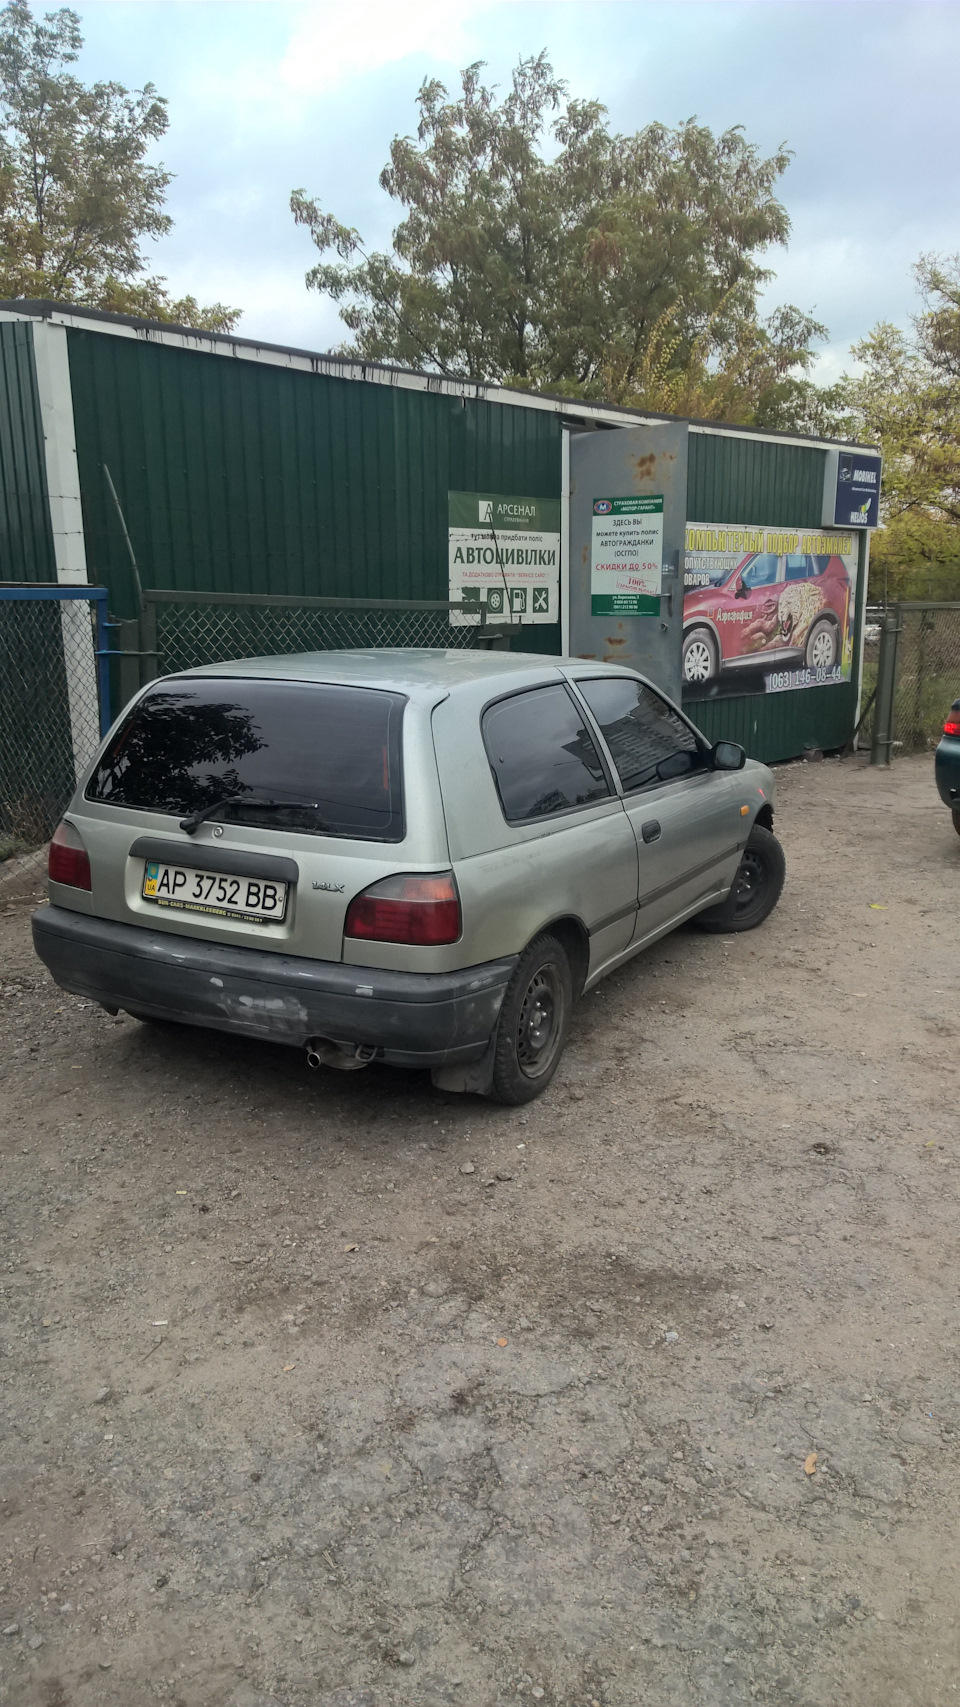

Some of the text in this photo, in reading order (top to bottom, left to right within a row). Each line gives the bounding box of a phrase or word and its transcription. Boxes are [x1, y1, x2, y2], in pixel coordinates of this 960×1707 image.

[497, 504, 536, 516] АРСЕНАЛ
[613, 519, 631, 527] ЗДЕСЬ
[501, 534, 528, 542] придбати
[600, 539, 654, 547] АВТОГРАЖДАНКИ
[767, 532, 799, 557] ПОДБОР
[801, 533, 852, 556] АВТОЭМАЛЕЙ
[453, 547, 556, 568] АВТОЦИВІЛКИ
[595, 563, 627, 571] СКИДКИ
[629, 563, 640, 571] ДО
[684, 557, 738, 571] ОПУТСТВУЮЩИХ
[683, 573, 710, 586] ОВАРОВ
[769, 666, 842, 691] (063) 146-08-44
[147, 884, 156, 892] UA
[157, 869, 277, 911] AP 3752 BB
